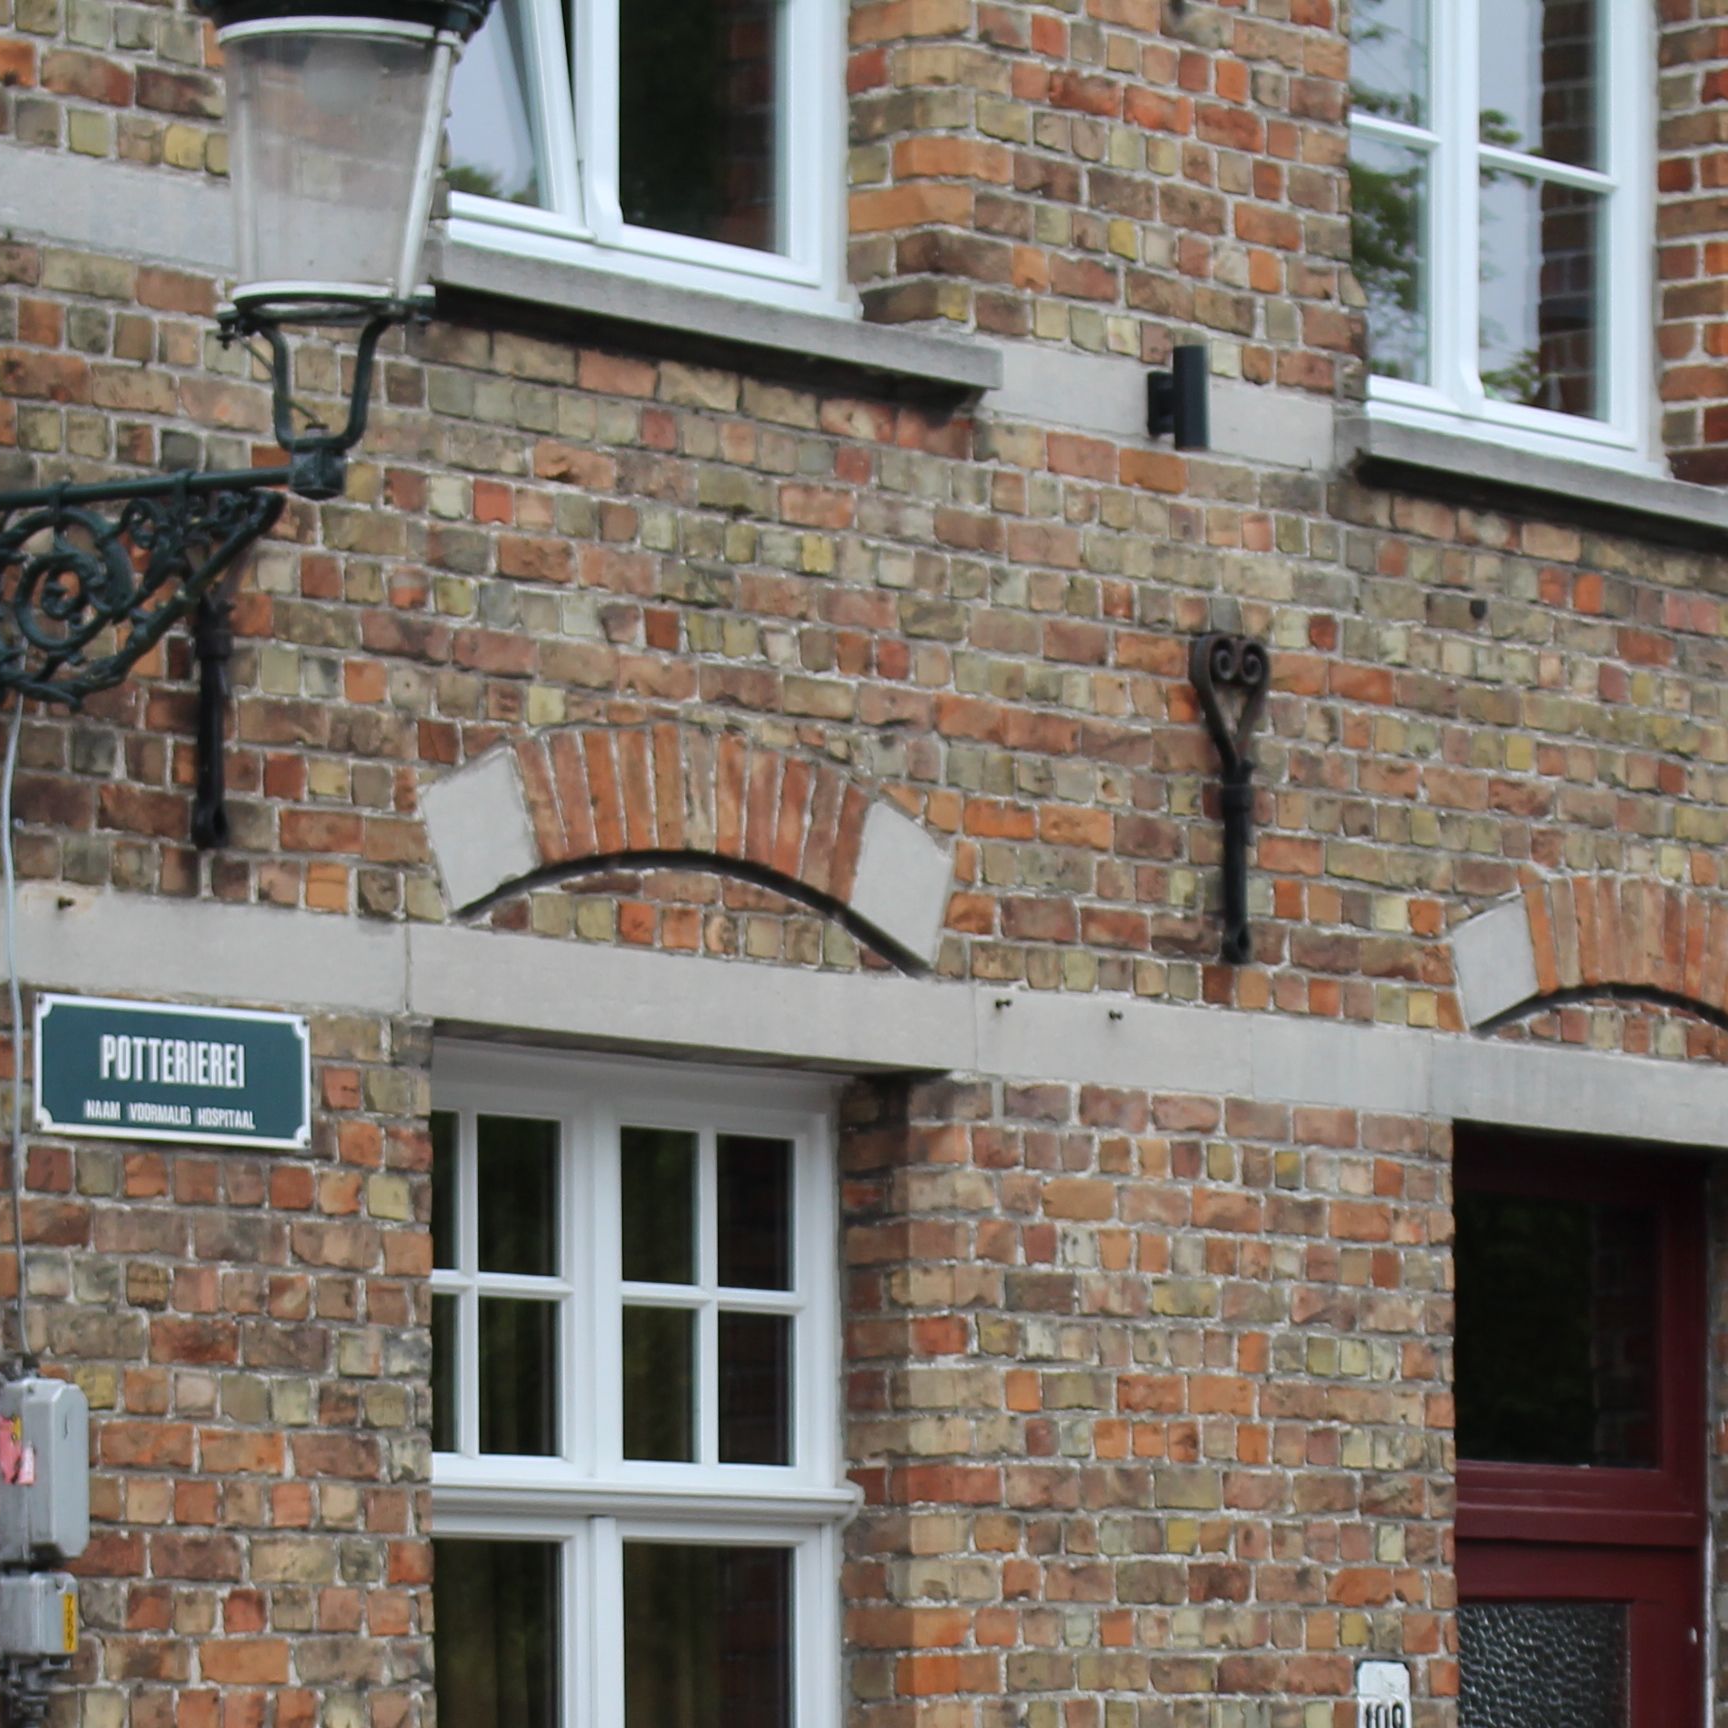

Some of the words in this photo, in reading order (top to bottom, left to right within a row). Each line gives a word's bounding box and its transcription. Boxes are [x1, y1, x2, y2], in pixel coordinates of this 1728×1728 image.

[100, 1034, 245, 1088] POTTERIEREI
[84, 1099, 121, 1120] NAAM
[128, 1102, 191, 1125] VOORMALIG
[197, 1107, 256, 1129] HOSPITAAL
